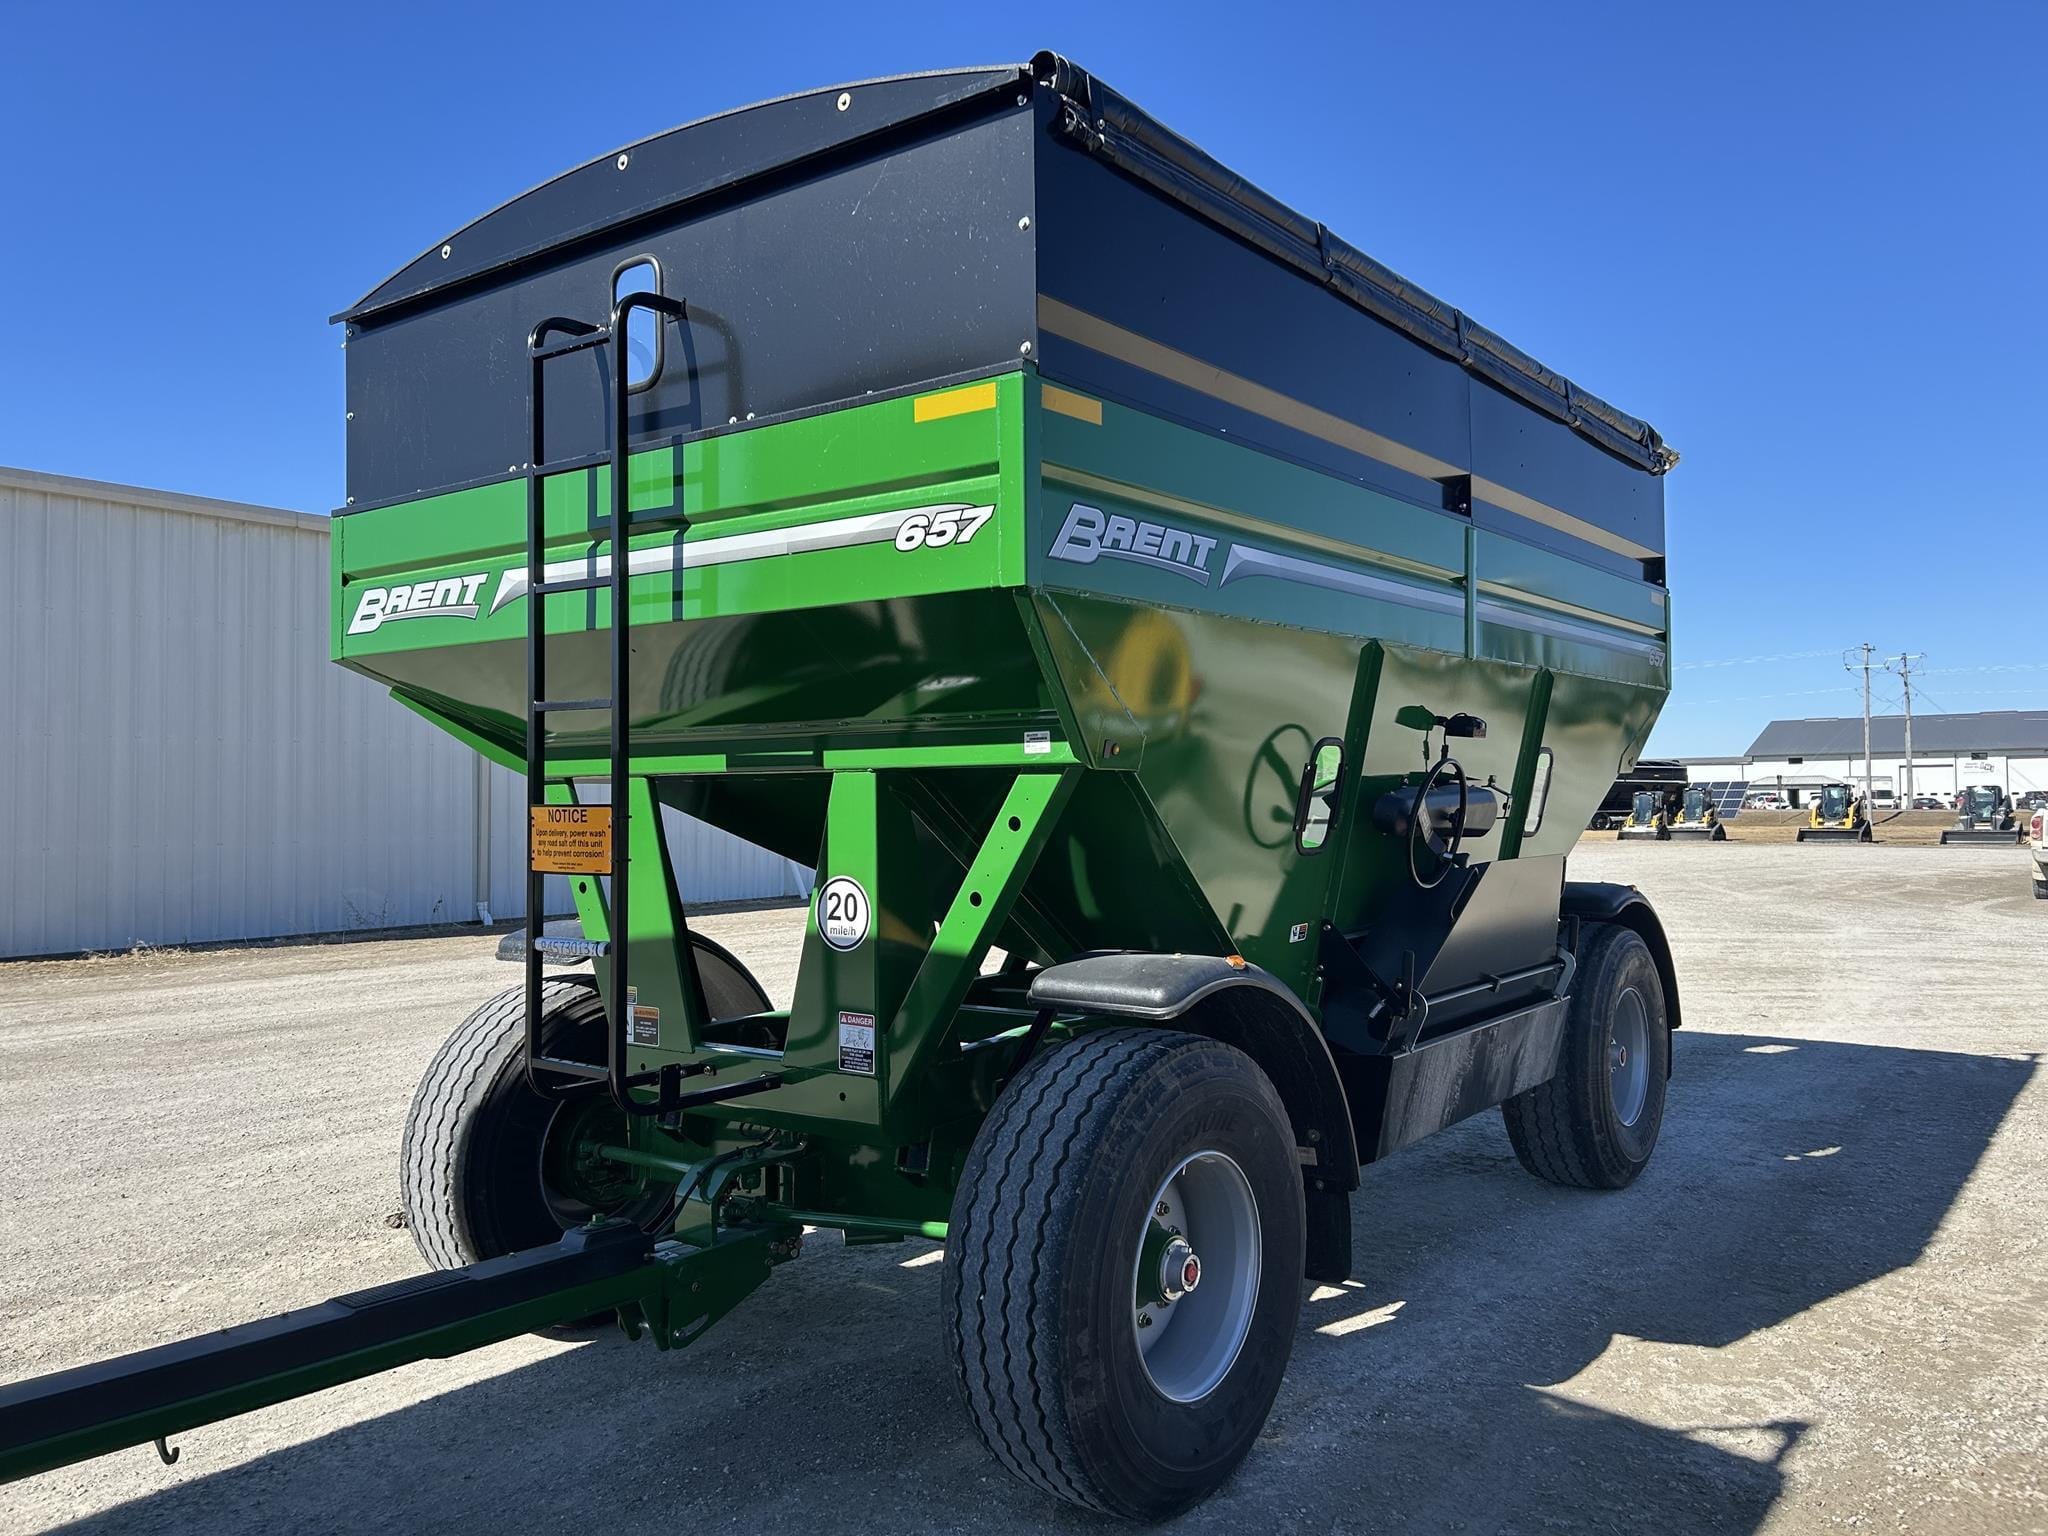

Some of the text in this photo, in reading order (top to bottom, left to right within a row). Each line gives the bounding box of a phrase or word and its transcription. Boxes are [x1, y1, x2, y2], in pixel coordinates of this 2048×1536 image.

[895, 503, 996, 552] 657
[1047, 503, 1218, 568] BRENT
[346, 572, 490, 636] BRENT
[1648, 648, 1666, 668] 657
[548, 808, 588, 823] NOTICE
[570, 830, 588, 838] power
[589, 829, 606, 838] wash
[577, 840, 589, 848] this
[590, 840, 603, 848] unit
[827, 892, 858, 922] 20
[829, 925, 857, 936] mile/h
[847, 1015, 873, 1026] DANGER
